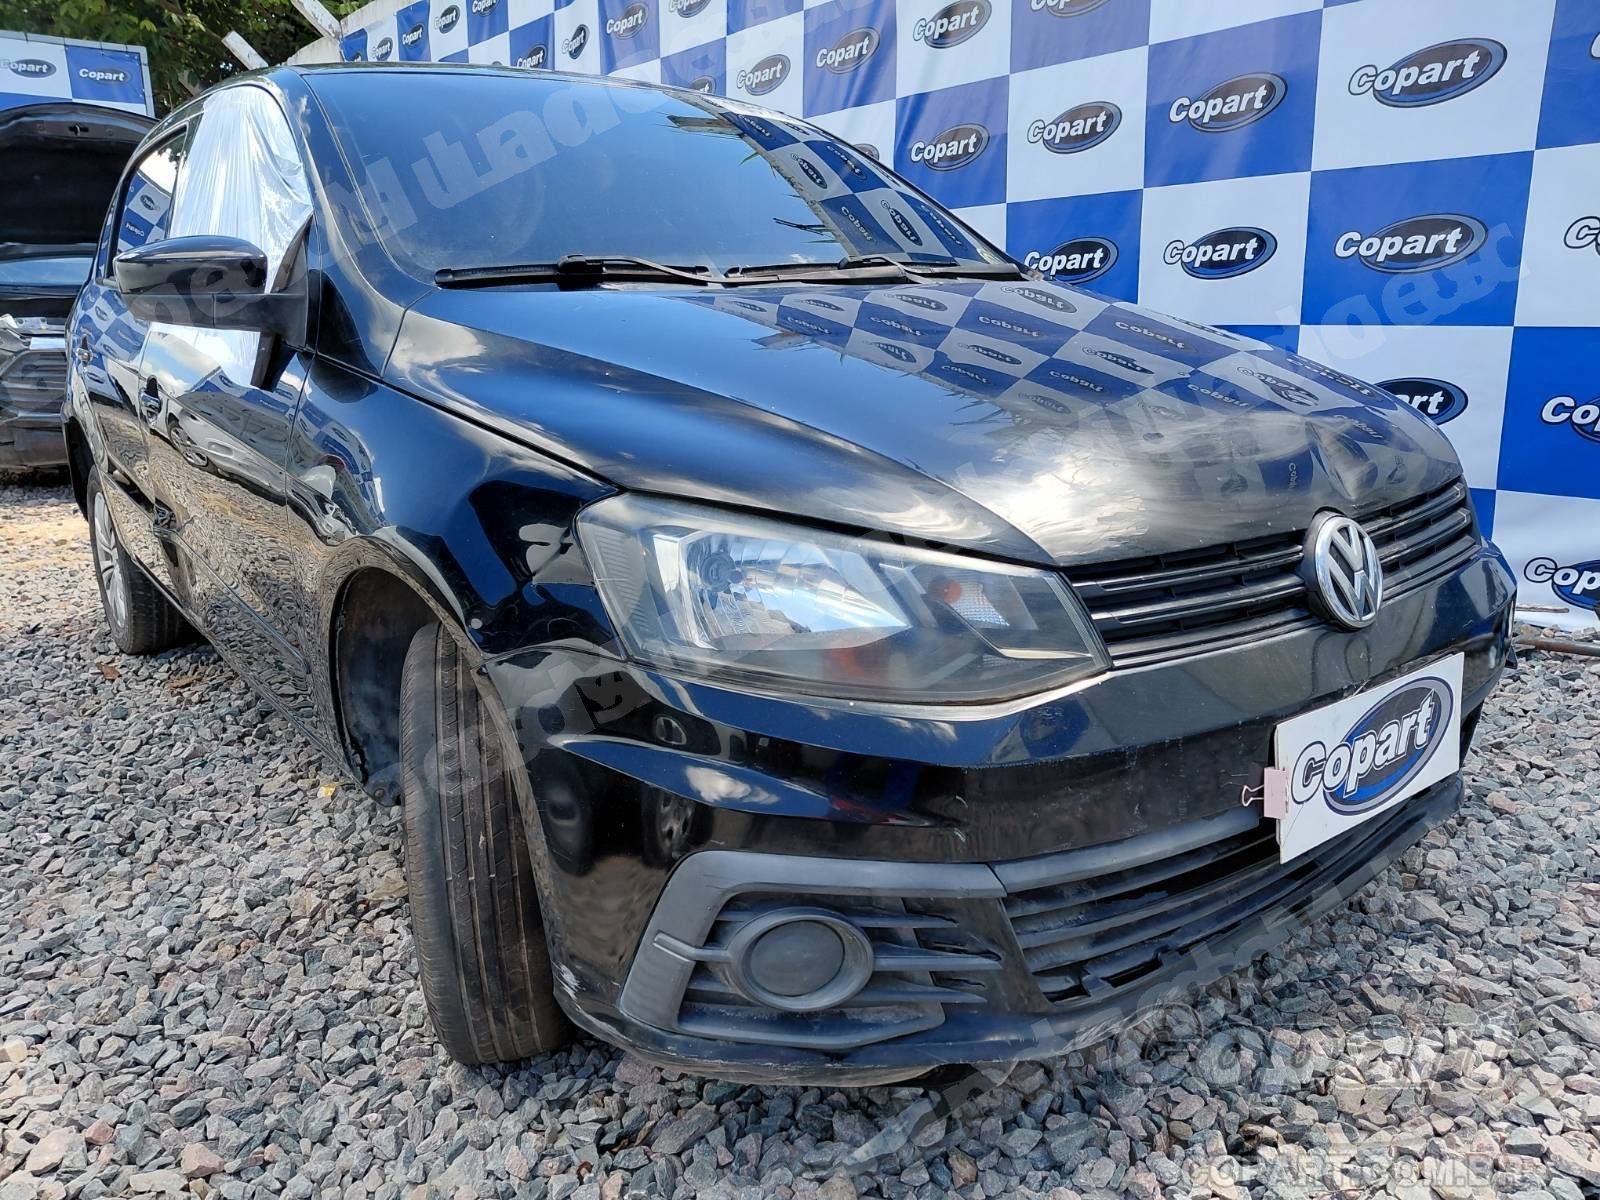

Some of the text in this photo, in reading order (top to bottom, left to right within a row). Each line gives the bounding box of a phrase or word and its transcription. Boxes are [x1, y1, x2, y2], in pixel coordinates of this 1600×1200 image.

[434, 8, 457, 30] Copart
[606, 8, 643, 34] Copart
[912, 5, 981, 42] Copart
[402, 27, 423, 45] Copart
[562, 30, 586, 54] Copart
[817, 36, 869, 68] Copart
[79, 68, 125, 81] Copart
[736, 61, 783, 89] Copart
[1347, 49, 1481, 97] Copart
[1168, 84, 1269, 124] Copart
[1027, 110, 1108, 144] Copart
[910, 132, 977, 163] Copart
[1164, 236, 1260, 269] Copart
[1334, 226, 1463, 264] Copart
[1024, 247, 1104, 277] Copart
[1291, 690, 1436, 804] Copart
